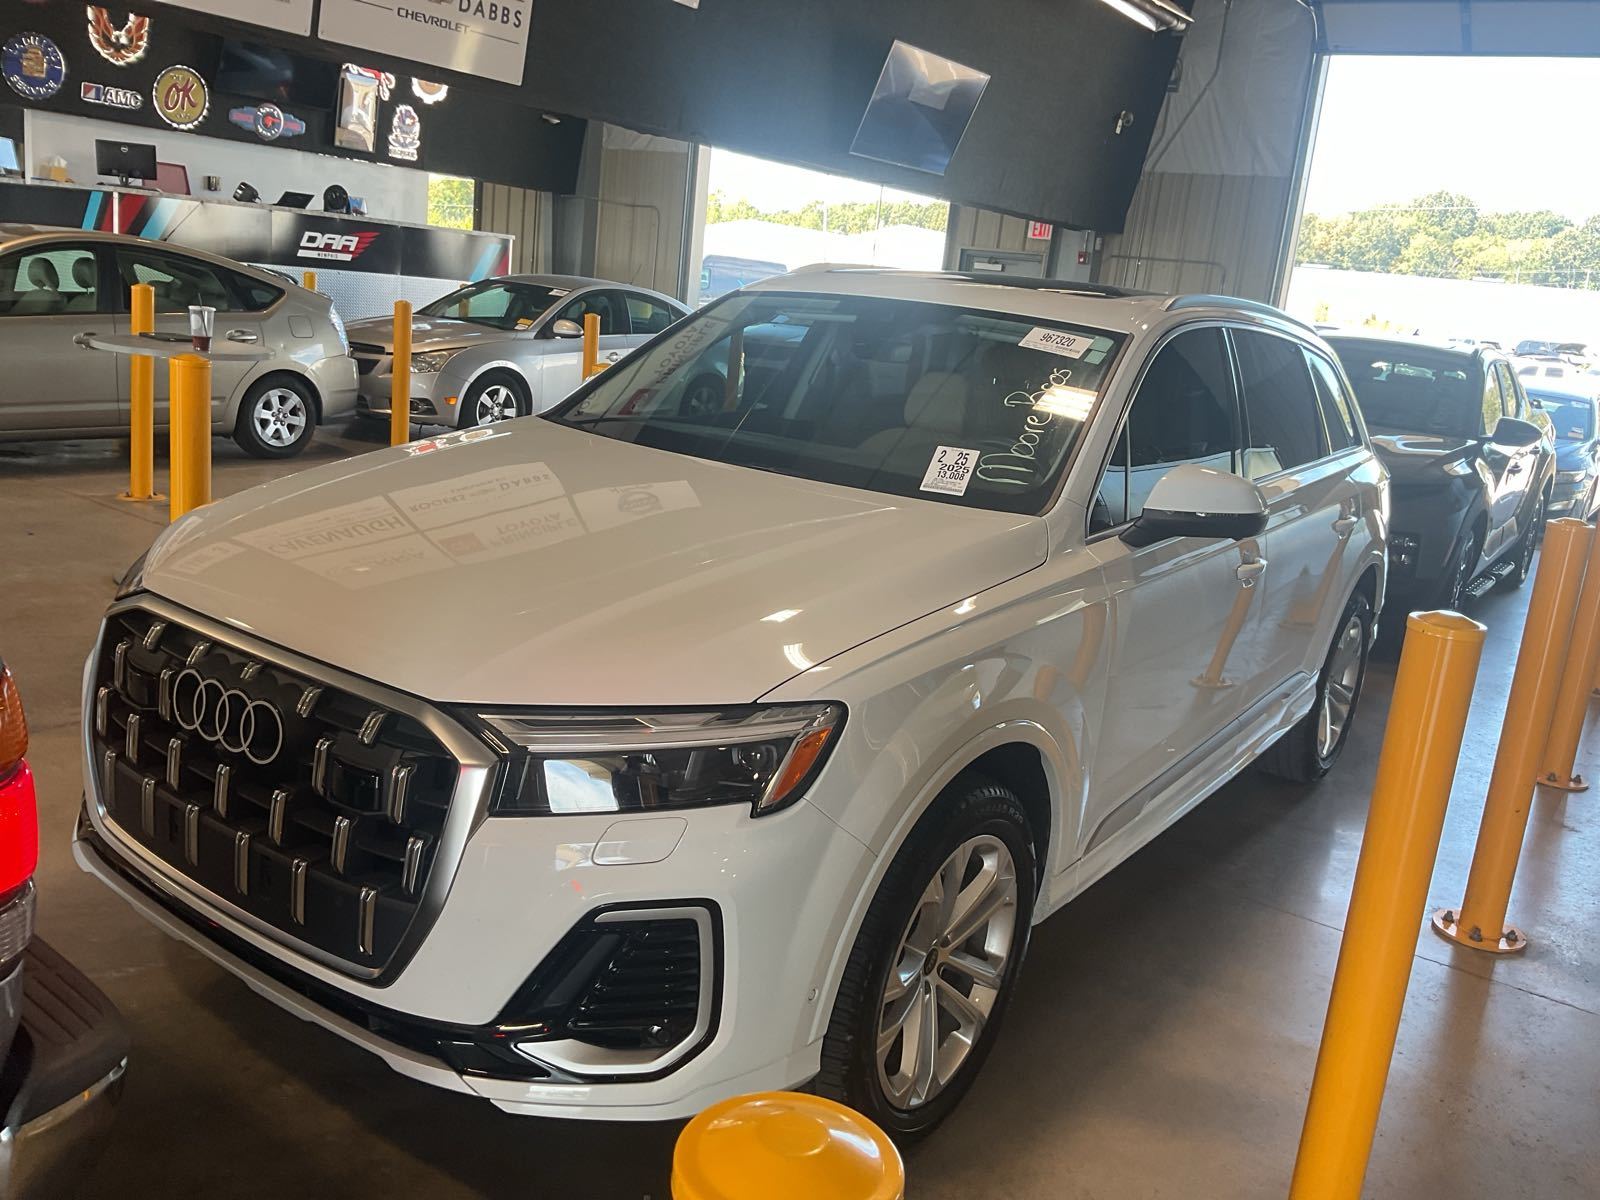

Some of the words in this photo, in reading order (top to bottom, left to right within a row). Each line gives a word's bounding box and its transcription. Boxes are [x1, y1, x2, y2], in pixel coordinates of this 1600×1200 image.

[397, 7, 470, 34] CHEVROLET
[458, 0, 522, 28] DABBS
[105, 87, 142, 108] AMC
[163, 76, 198, 112] OK
[300, 231, 359, 251] DAA
[1040, 333, 1076, 348] 967320
[937, 450, 947, 463] 2
[954, 452, 970, 466] 25
[977, 413, 1053, 485] Moore
[939, 463, 971, 474] 2025
